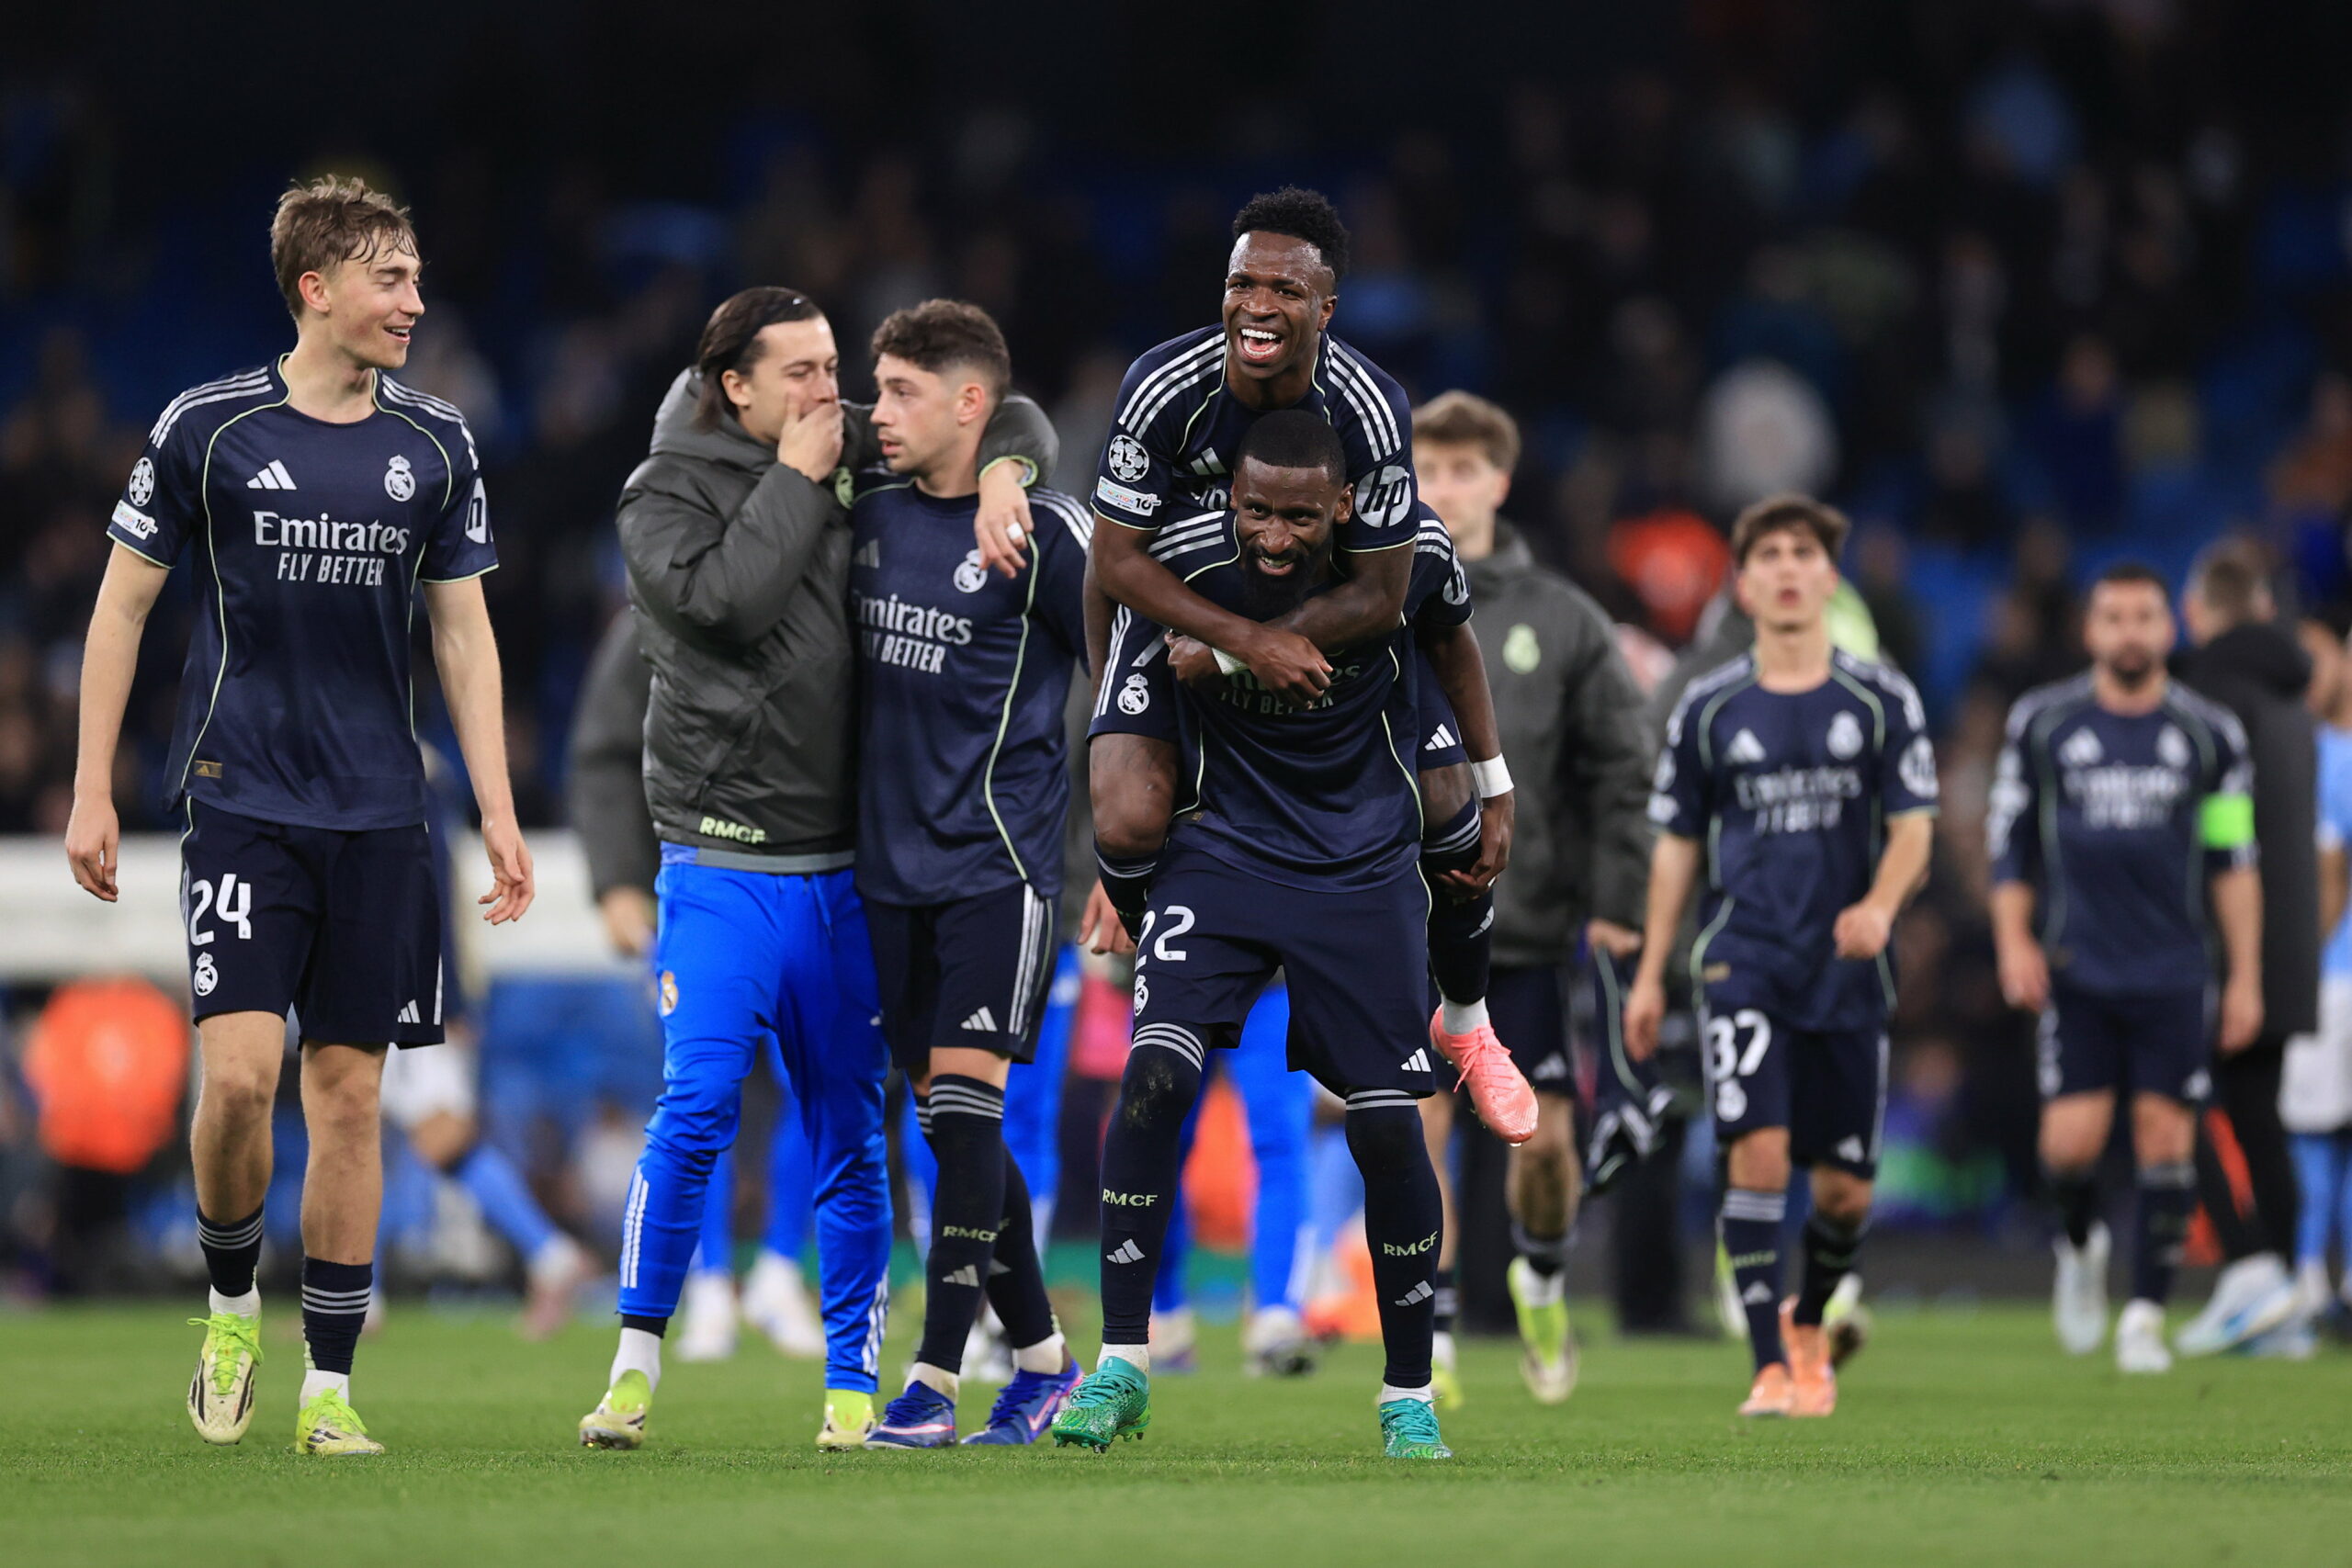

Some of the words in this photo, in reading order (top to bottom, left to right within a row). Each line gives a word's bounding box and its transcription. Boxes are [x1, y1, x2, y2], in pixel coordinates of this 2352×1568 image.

[1362, 468, 1408, 528] hp
[253, 511, 411, 555] Emirates
[277, 552, 313, 581] FLY
[317, 555, 385, 586] BETTER
[860, 592, 973, 646] mirates
[880, 635, 946, 674] BETTER
[699, 816, 766, 844] RMCF
[189, 874, 253, 947] 24
[1134, 905, 1196, 972] 22
[1706, 1008, 1772, 1081] 37
[1102, 1188, 1158, 1207] RMCF
[1383, 1231, 1438, 1257] RMCF
